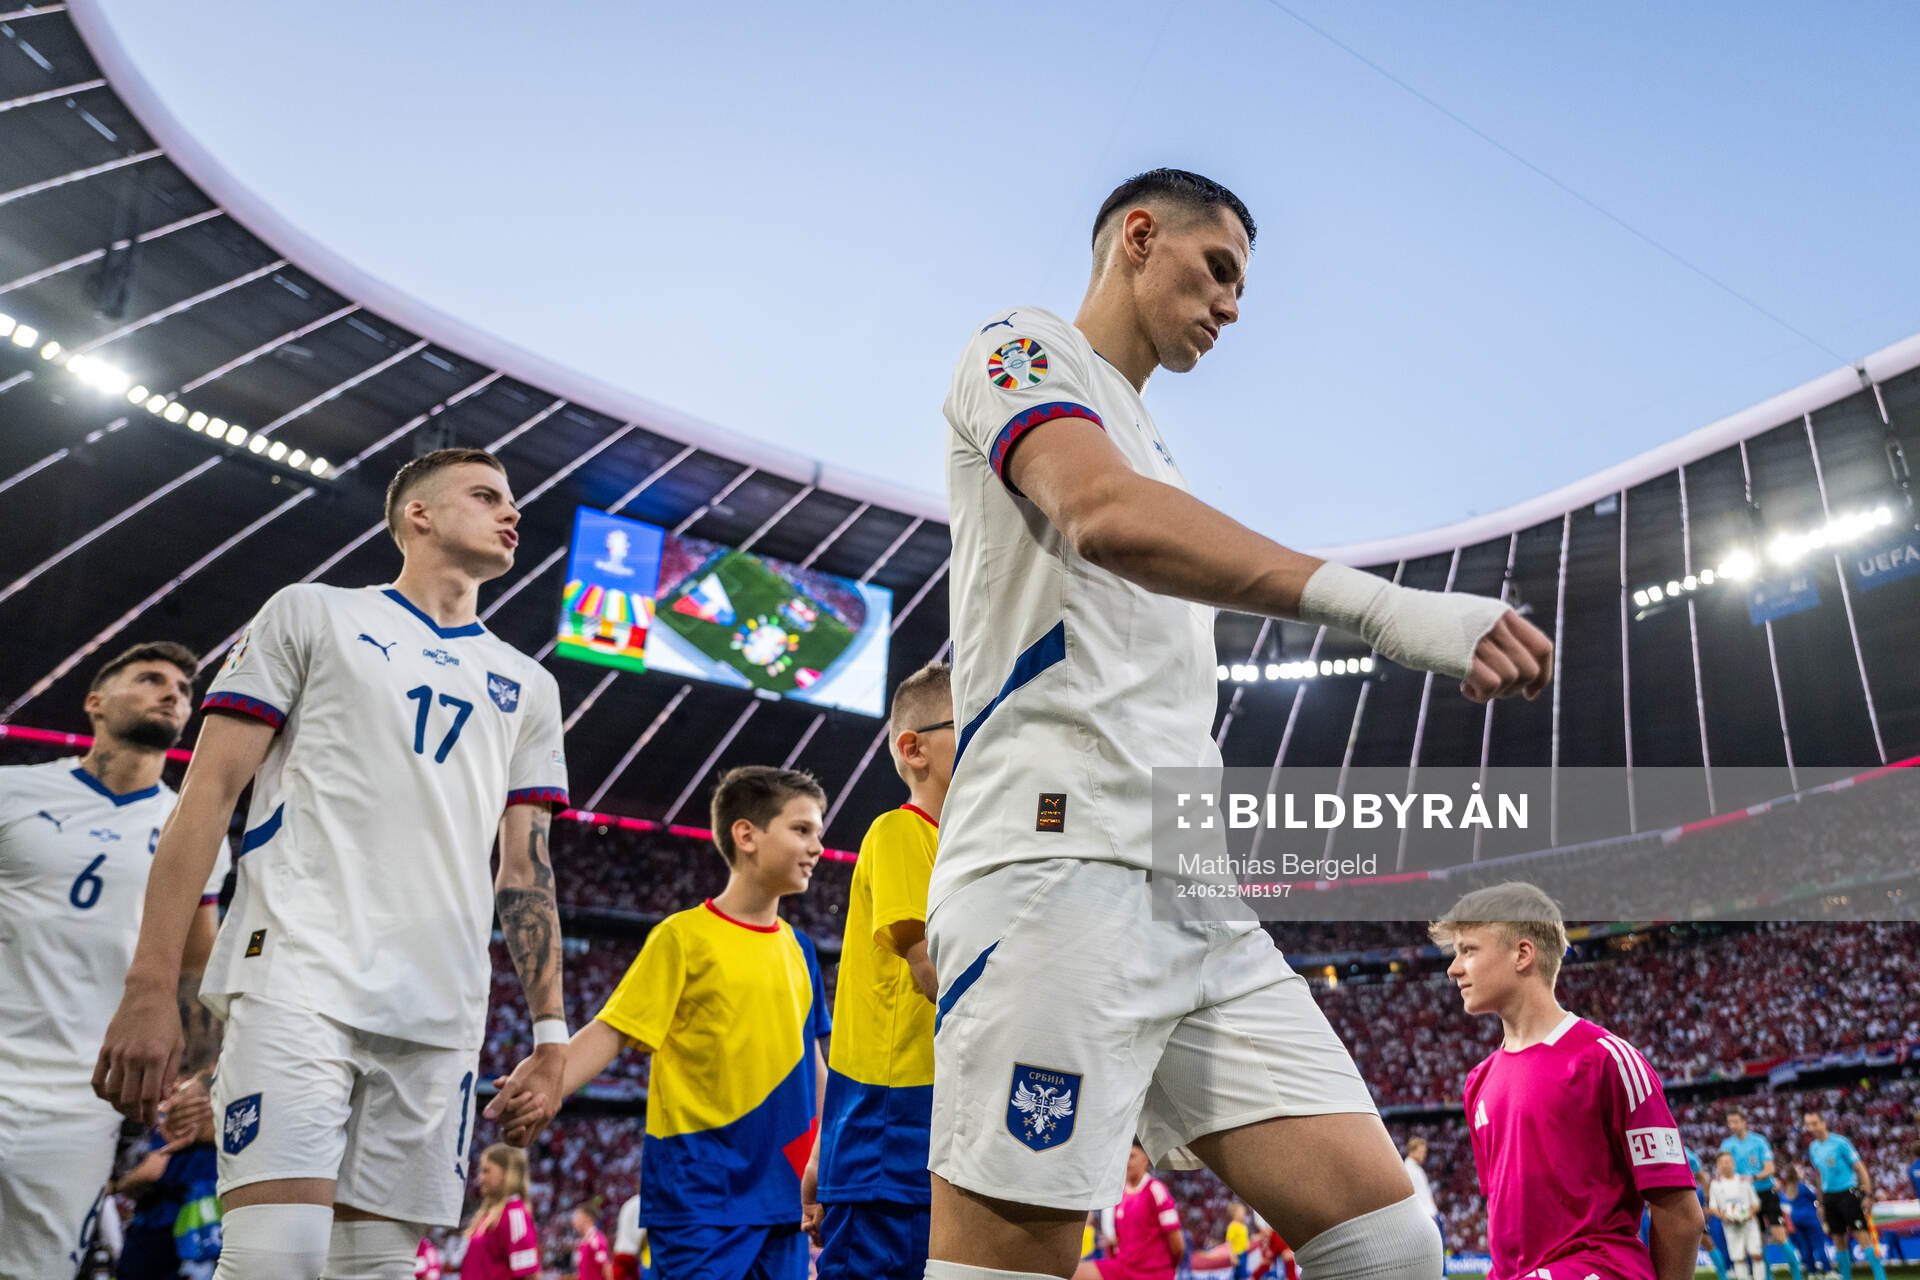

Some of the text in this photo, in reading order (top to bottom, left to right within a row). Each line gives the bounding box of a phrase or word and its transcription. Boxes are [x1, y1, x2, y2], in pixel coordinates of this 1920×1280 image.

[1858, 544, 1920, 577] UEFA
[406, 685, 474, 764] 17
[69, 853, 107, 909] 6
[1028, 1071, 1065, 1085] СРБИЈА
[457, 1071, 478, 1156] 1
